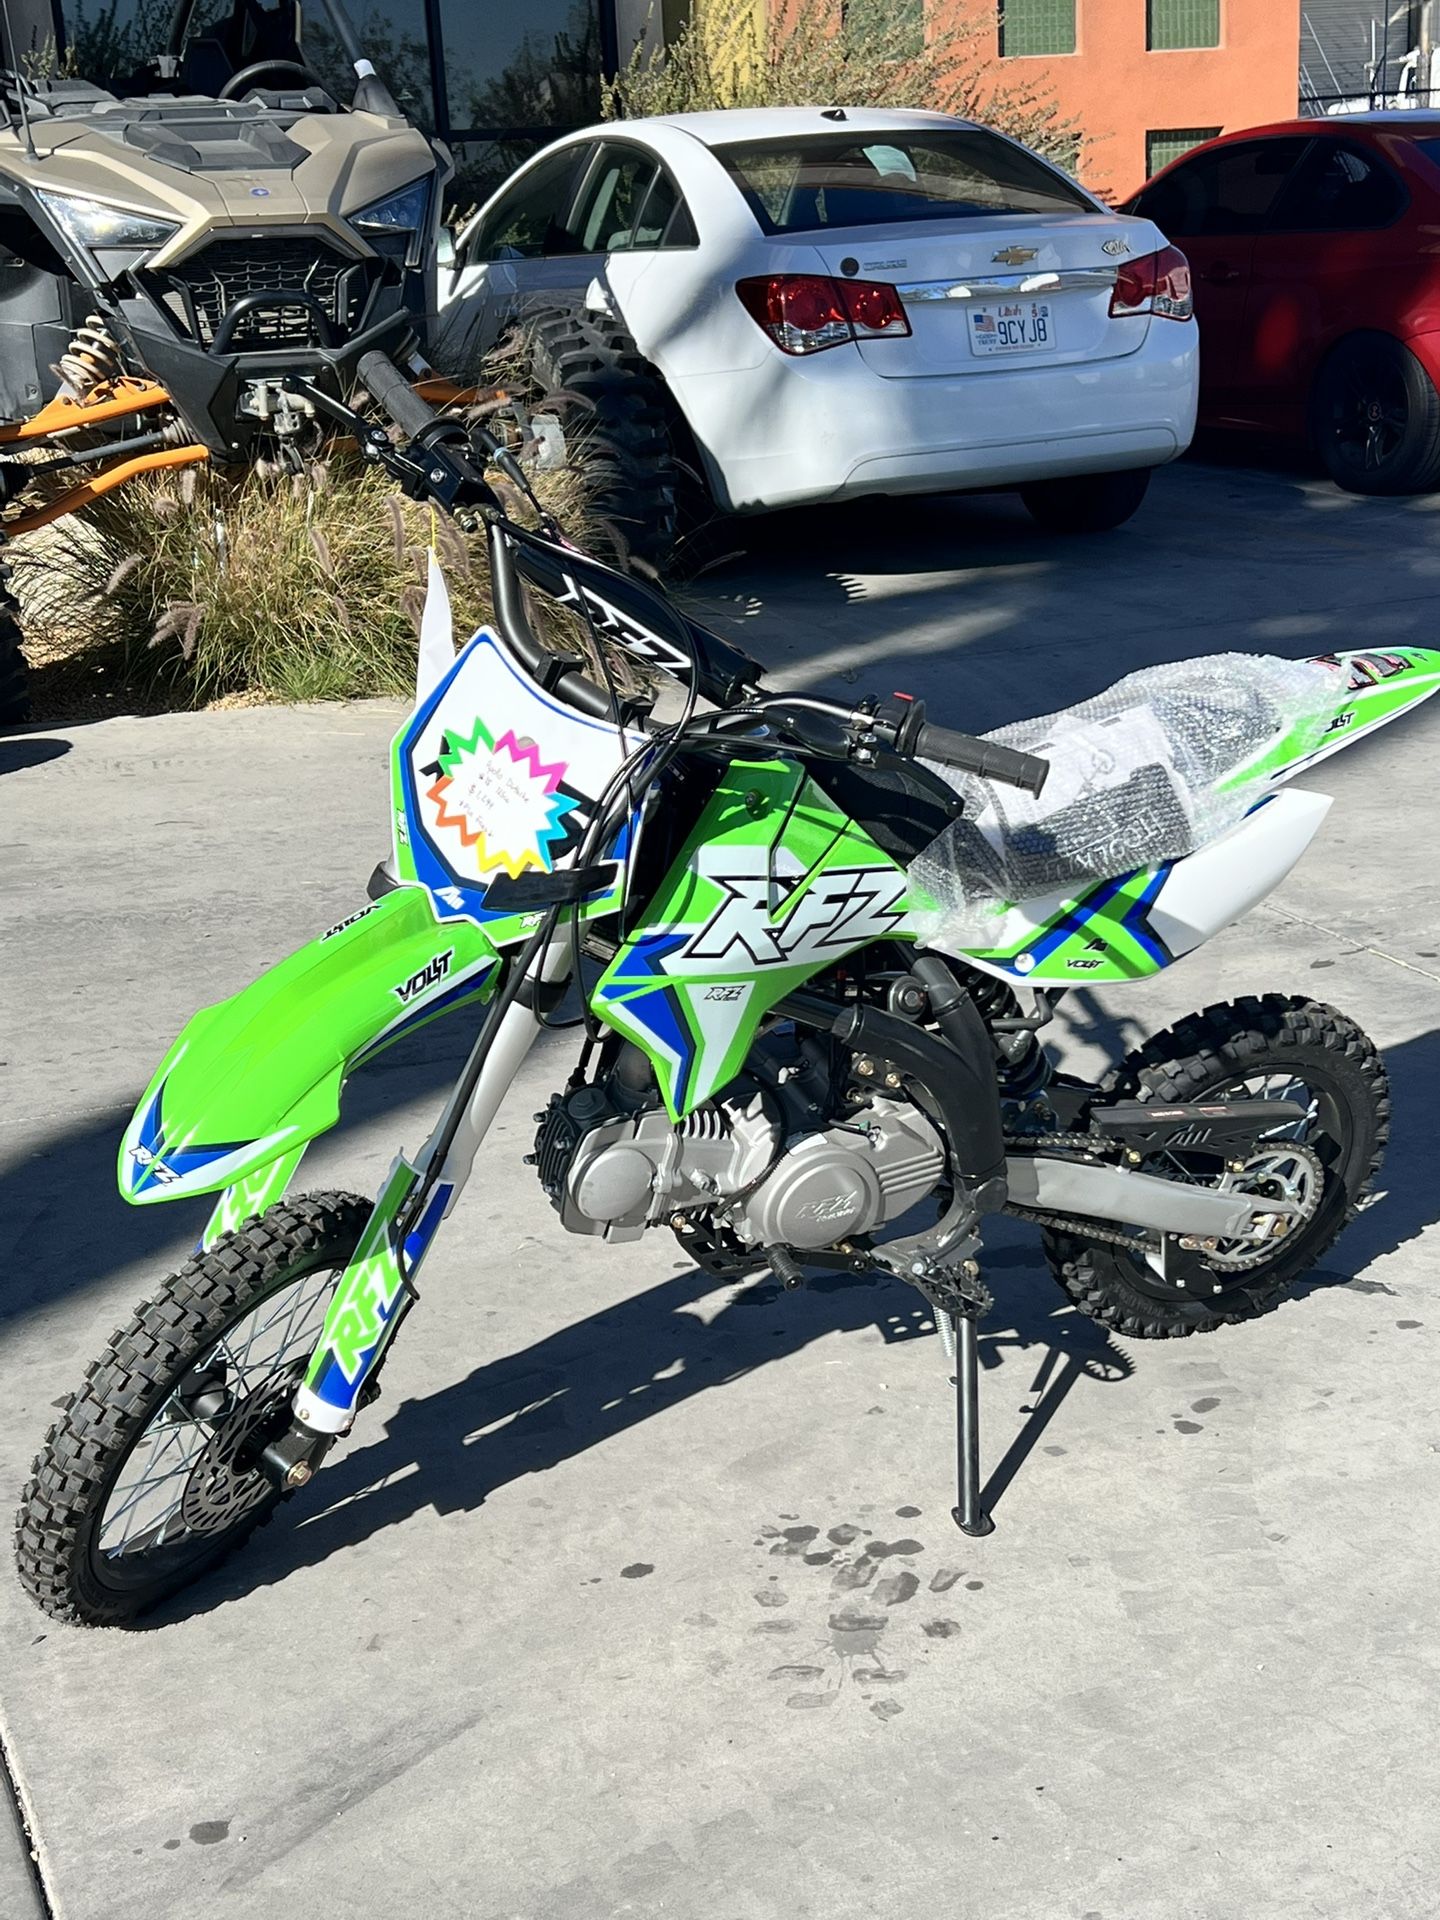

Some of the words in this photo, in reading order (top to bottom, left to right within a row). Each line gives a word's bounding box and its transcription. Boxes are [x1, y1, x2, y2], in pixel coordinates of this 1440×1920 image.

[998, 304, 1021, 318] Utah
[322, 904, 382, 941] VOLT
[520, 911, 548, 929] RF
[681, 867, 908, 966] RFZ
[395, 950, 453, 1002] VOLT
[1067, 959, 1105, 968] VOLT
[704, 985, 746, 1001] RFZ
[321, 1217, 414, 1385] RFZ
